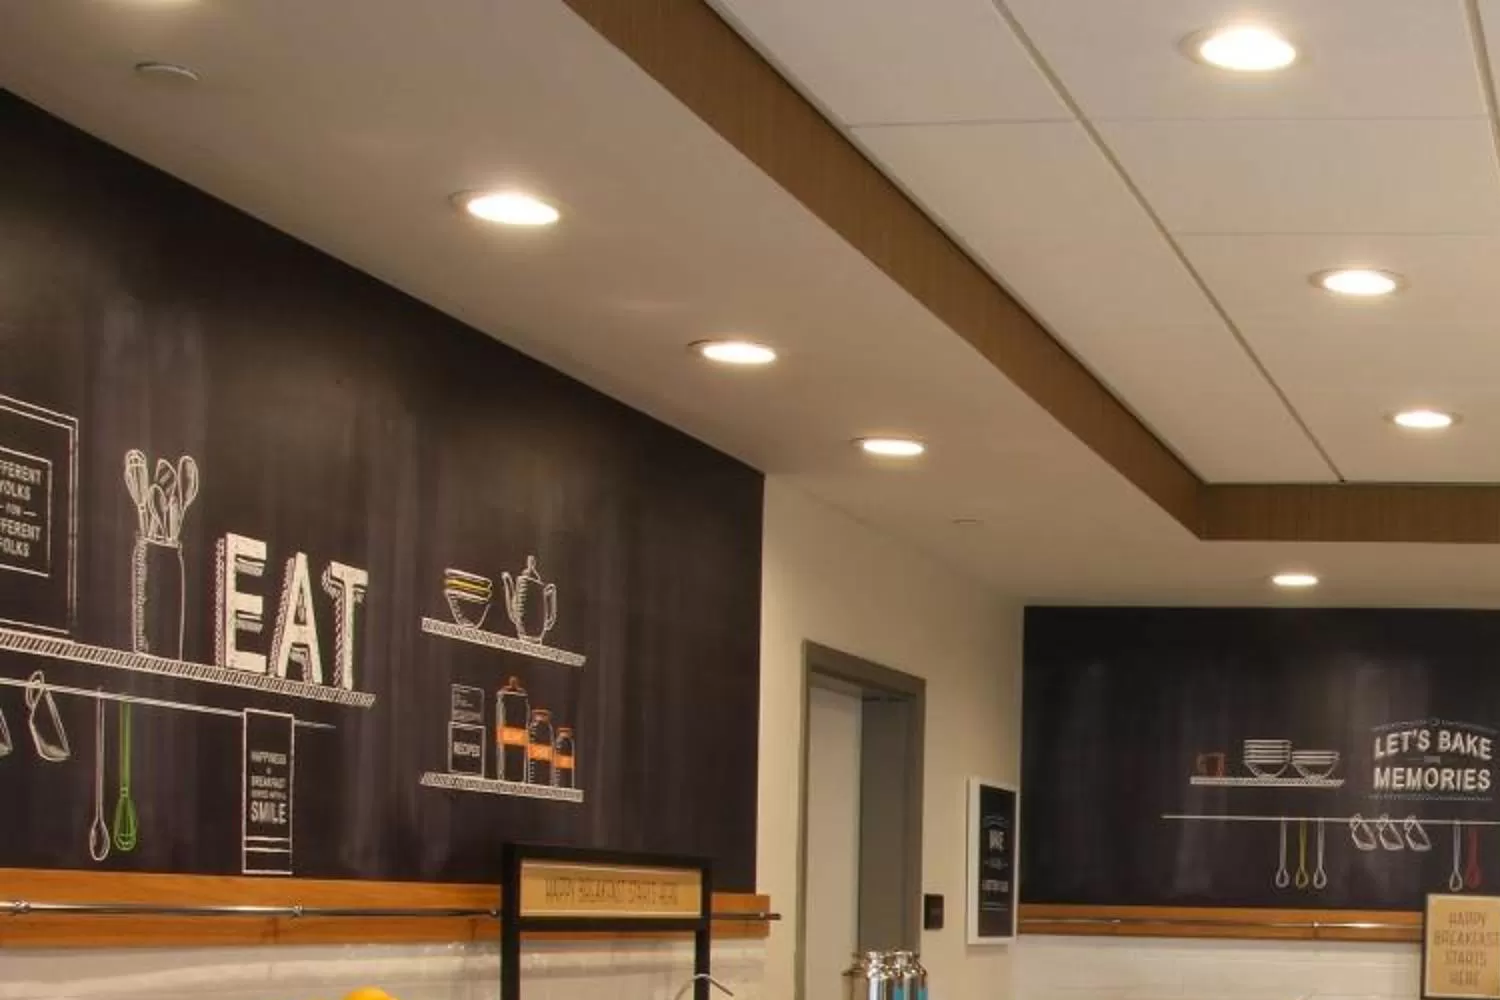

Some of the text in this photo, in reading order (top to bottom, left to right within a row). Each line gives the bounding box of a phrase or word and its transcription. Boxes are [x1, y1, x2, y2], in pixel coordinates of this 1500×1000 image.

[216, 532, 369, 690] EAT
[1374, 728, 1493, 760] LET'S BAKE
[1373, 766, 1491, 792] MEMORIES
[251, 800, 287, 824] SMILE
